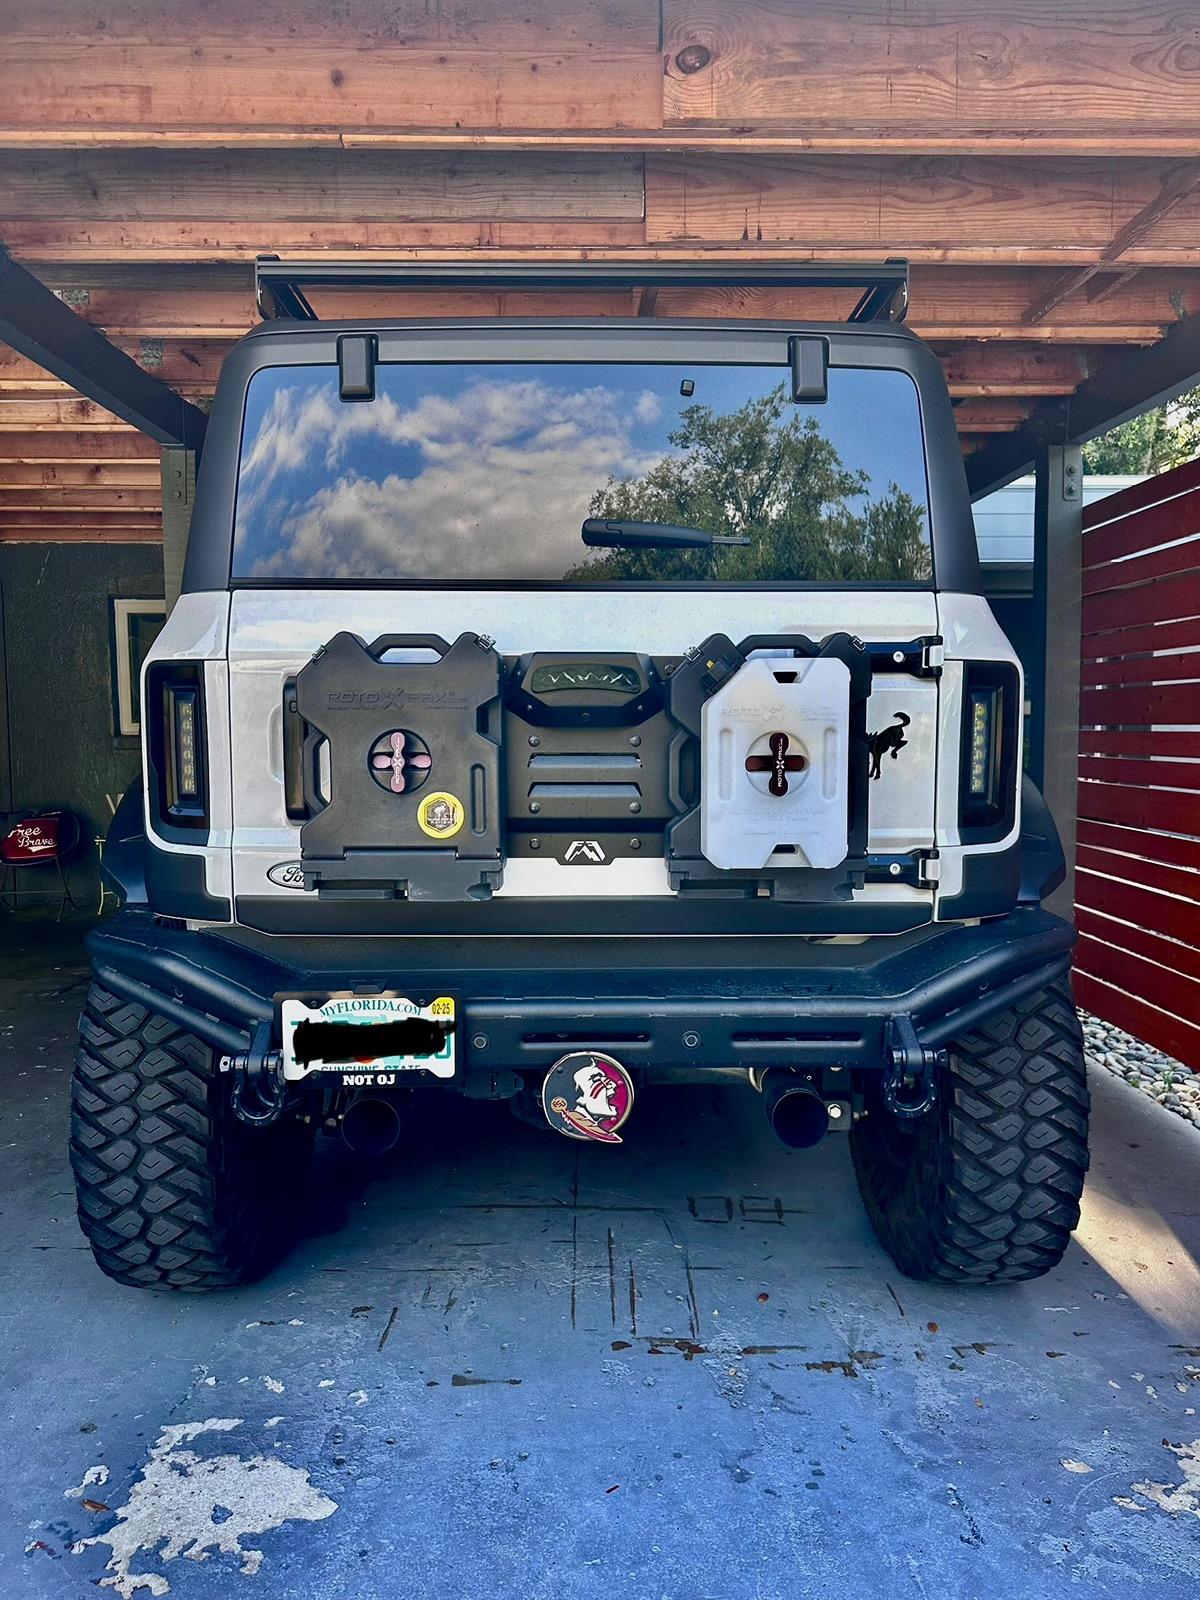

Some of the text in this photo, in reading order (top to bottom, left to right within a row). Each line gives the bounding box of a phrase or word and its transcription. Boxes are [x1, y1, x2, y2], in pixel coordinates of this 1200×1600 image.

[17, 836, 55, 848] Brave
[431, 1003, 451, 1015] 02-25
[342, 1074, 396, 1086] NOT OJ
